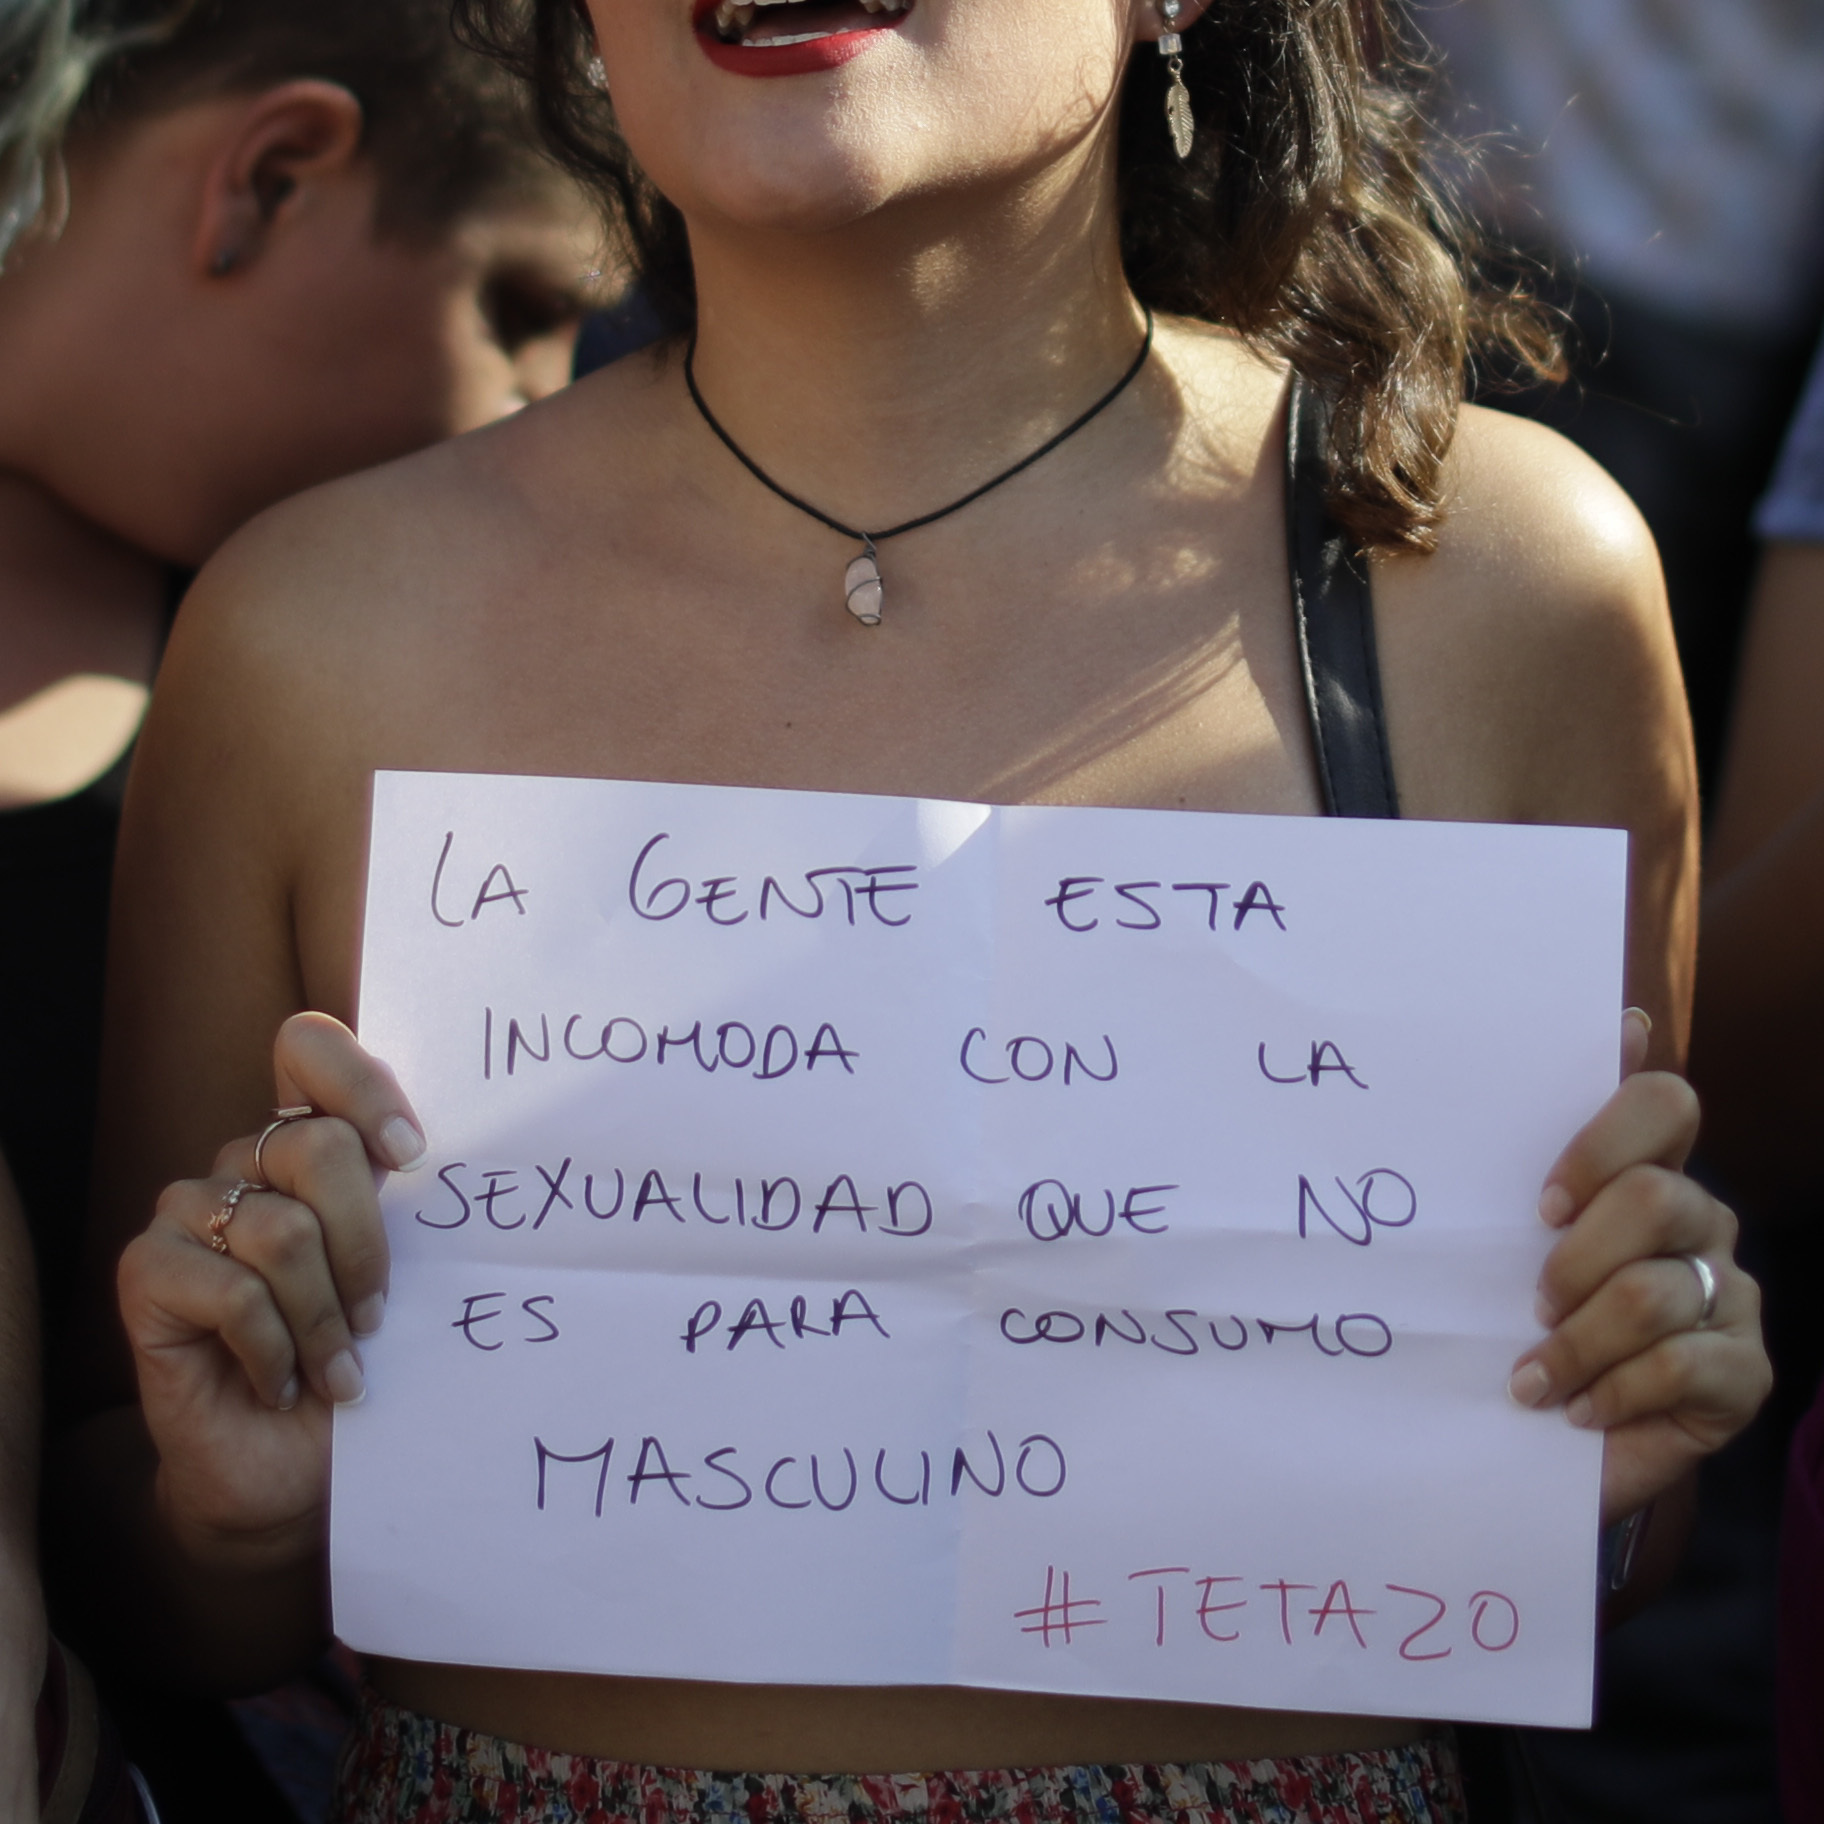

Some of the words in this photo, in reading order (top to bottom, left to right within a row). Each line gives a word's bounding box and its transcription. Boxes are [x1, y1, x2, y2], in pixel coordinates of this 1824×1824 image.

[428, 829, 531, 929] LA
[626, 830, 922, 929] GENTE
[1042, 875, 1289, 934] ESTA
[481, 1005, 862, 1082] INCOMODA
[958, 1025, 1121, 1088] CON
[1256, 1038, 1372, 1091] LA
[415, 1155, 936, 1238] SEXUALIDAD
[1016, 1176, 1182, 1244] QUE
[1295, 1166, 1419, 1248] NO
[449, 1290, 562, 1354] ES
[678, 1287, 893, 1356] PARA
[998, 1306, 1395, 1359] CONSUMO
[531, 1426, 1068, 1520] MASCULINO
